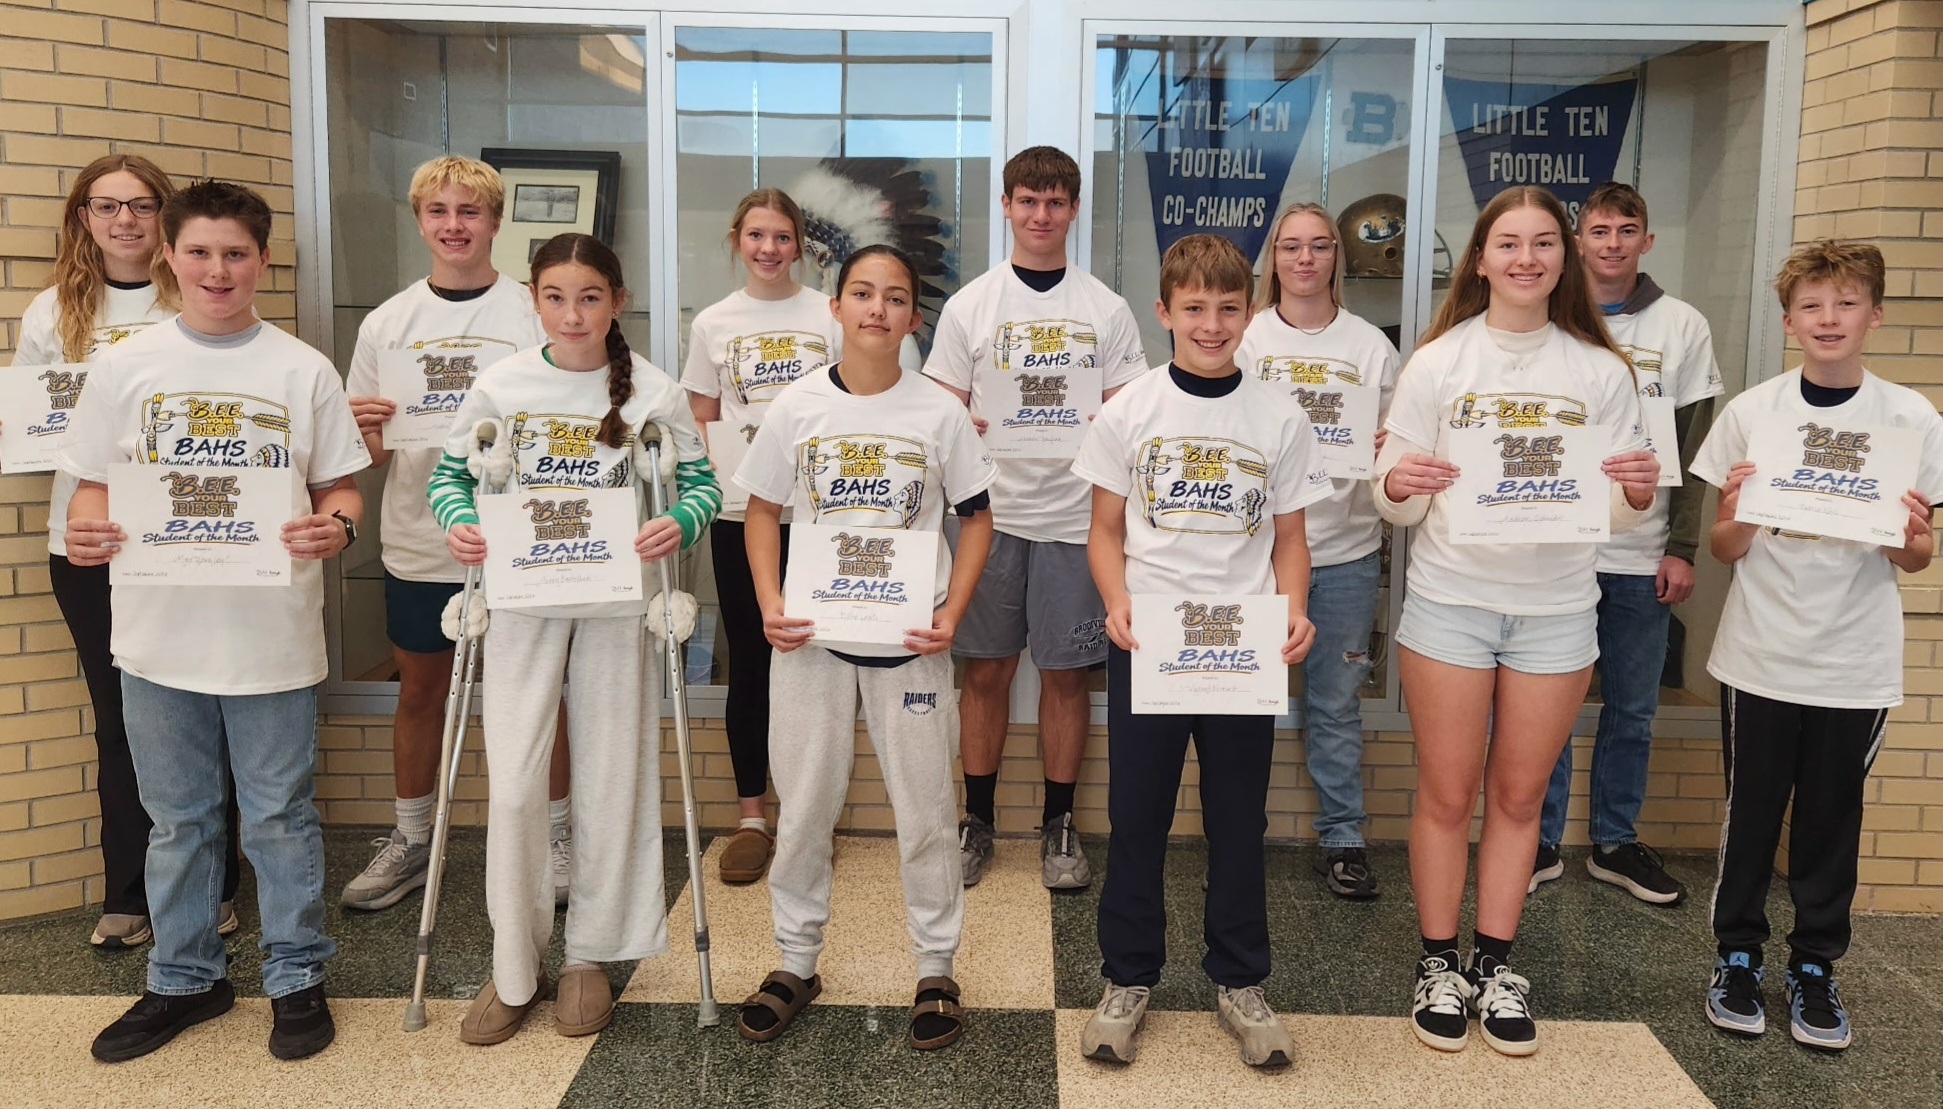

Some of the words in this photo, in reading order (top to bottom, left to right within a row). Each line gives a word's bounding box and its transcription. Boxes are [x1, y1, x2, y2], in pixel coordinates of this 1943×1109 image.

[1157, 99, 1232, 132] LITTLE
[1247, 101, 1291, 132] TEN
[1347, 91, 1397, 145] B
[1473, 103, 1549, 136] LITTLE
[1565, 105, 1608, 136] TEN
[1169, 147, 1267, 180] FOOTBALL
[1490, 152, 1590, 183] FOOTBALL
[1163, 195, 1266, 228] CO-CHAMPS
[1023, 352, 1071, 367] BAHS
[754, 360, 802, 377] BAHS
[427, 377, 476, 391] BEST
[745, 378, 770, 389] Student
[1022, 394, 1066, 406] BEST
[180, 397, 244, 420] B.E.E.
[406, 404, 443, 414] Student
[1017, 408, 1077, 419] BAHS
[1491, 398, 1549, 419] B.E.E.
[1002, 418, 1034, 426] Student
[1307, 411, 1341, 424] EST
[188, 422, 241, 437] BEST
[1798, 422, 1871, 453] B.E.E.
[174, 437, 247, 457] BAHS
[564, 438, 589, 446] YOUR
[1317, 436, 1329, 444] the
[1494, 434, 1565, 460] B.E.E.
[548, 442, 595, 458] BEST
[833, 440, 888, 462] B.E.E.
[1176, 442, 1231, 465] B.E.E.
[1825, 448, 1857, 457] YOUR
[160, 457, 194, 466] Student
[196, 457, 206, 466] of
[207, 457, 219, 466] the
[536, 456, 601, 476] BAHS
[1504, 461, 1561, 477] BEST
[1803, 450, 1865, 473] BEST
[840, 464, 886, 477] BEST
[1182, 466, 1228, 481] BEST
[160, 472, 241, 499] B.E.E.
[521, 473, 554, 486] Student
[556, 474, 564, 487] of
[564, 476, 576, 486] the
[577, 478, 601, 489] Month
[830, 478, 891, 496] BAHS
[1496, 479, 1577, 493] BAHS
[1793, 468, 1879, 490] BAHS
[1170, 480, 1233, 500] BAHS
[1771, 478, 1817, 491] Student
[1819, 485, 1828, 494] of
[1830, 485, 1847, 495] the
[1849, 489, 1881, 501] Month
[849, 497, 856, 508] of
[858, 496, 869, 506] the
[870, 498, 893, 508] Month
[1155, 498, 1187, 511] Student
[1189, 500, 1196, 512] of
[1197, 499, 1208, 509] the
[1210, 501, 1234, 513] Month
[1477, 493, 1520, 504] Student
[1522, 493, 1531, 502] of
[1550, 492, 1581, 500] Month
[172, 500, 237, 517] BEST
[522, 498, 592, 524] B.E.E.
[165, 519, 255, 533] BAHS
[553, 517, 582, 525] YOUR
[142, 533, 192, 543] Student
[194, 534, 204, 543] of
[226, 533, 261, 542] Month
[535, 523, 591, 541] BEST
[530, 540, 607, 556] BAHS
[831, 532, 895, 557] B.E.E.
[512, 556, 553, 568] Student
[556, 556, 565, 565] of
[583, 552, 613, 561] Month
[839, 560, 891, 578] BEST
[831, 578, 905, 593] BAHS
[812, 590, 852, 599] Student
[854, 592, 863, 600] of
[864, 592, 877, 600] the
[880, 594, 908, 603] Month
[1175, 601, 1244, 628] B.E.E.
[1185, 630, 1241, 646] BEST
[1178, 649, 1256, 662] BAHS
[1159, 662, 1201, 672] Student
[1203, 663, 1211, 671] of
[1213, 662, 1228, 670] the
[1230, 662, 1260, 671] Month
[903, 692, 937, 709] RAIDERS
